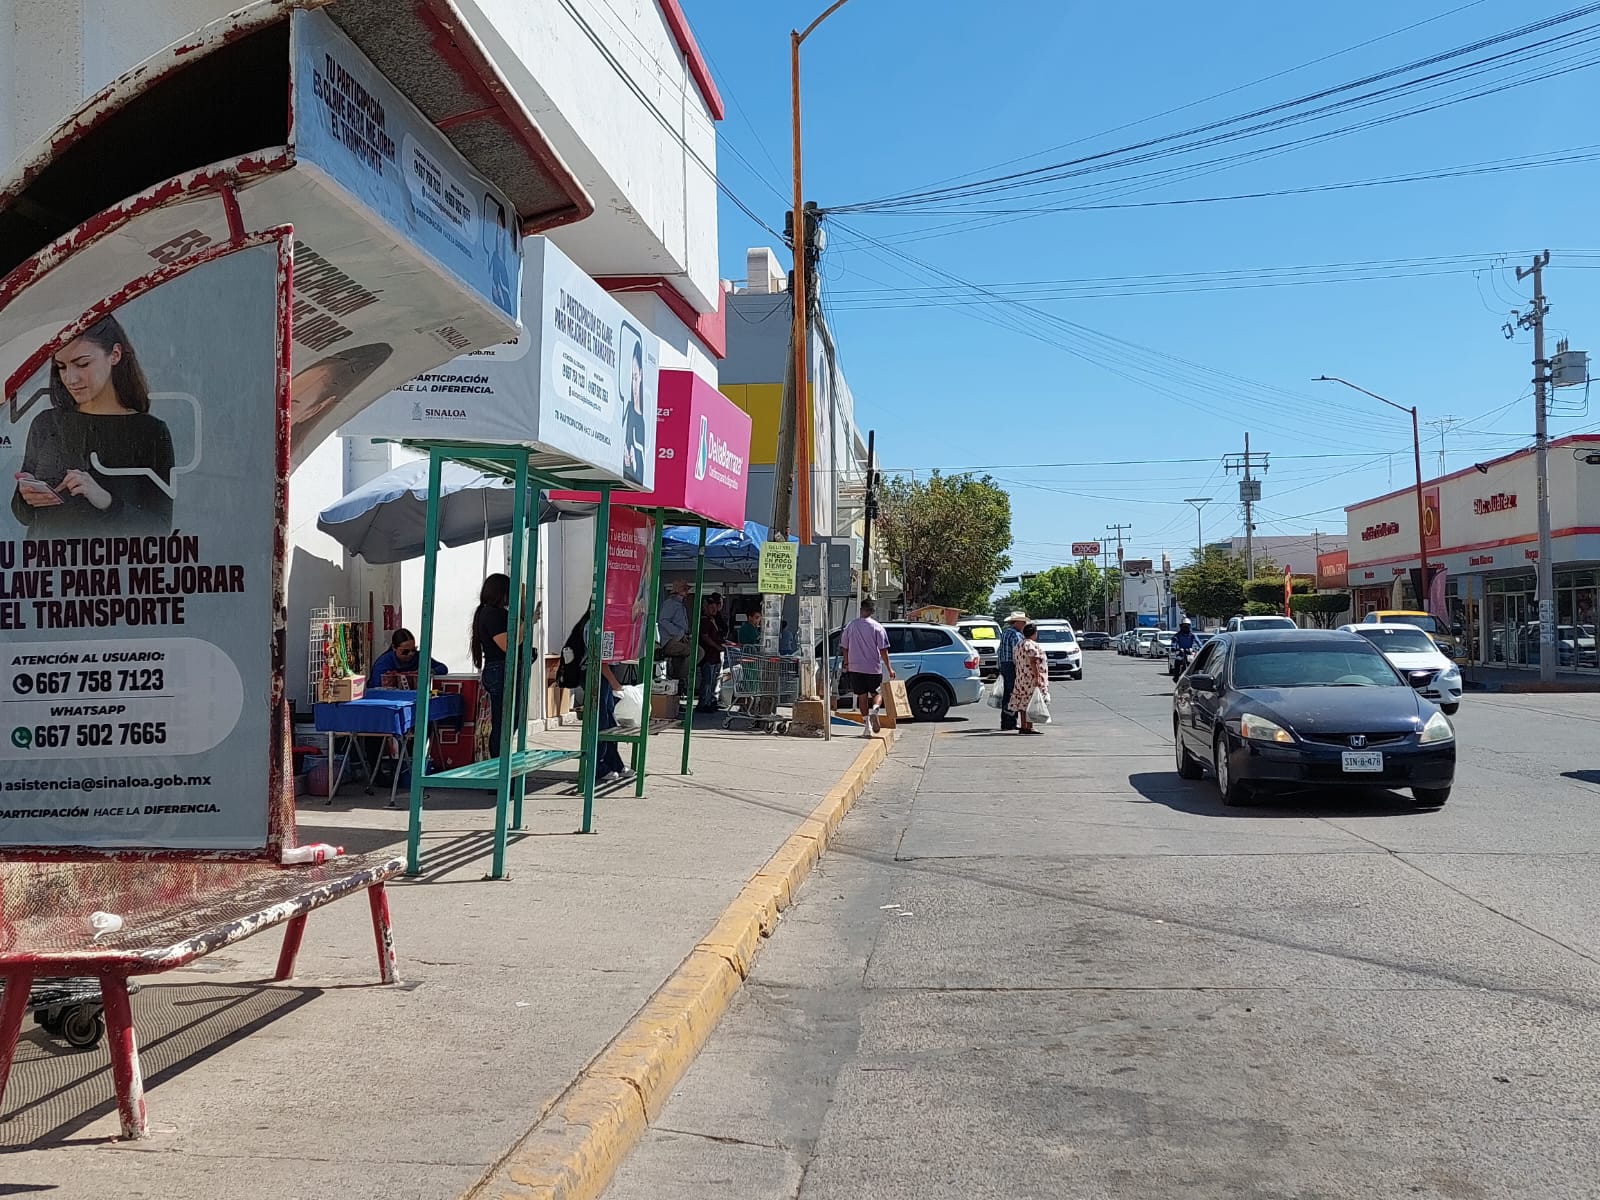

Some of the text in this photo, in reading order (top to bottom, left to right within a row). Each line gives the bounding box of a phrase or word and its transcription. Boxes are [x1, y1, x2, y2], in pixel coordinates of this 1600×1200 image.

[325, 53, 336, 83] TU
[147, 229, 212, 264] ES
[294, 241, 384, 318] RTICIPACIÓN
[431, 385, 494, 394] DIFERENCIA.
[425, 408, 467, 417] SINALOA
[23, 529, 199, 568] PARTICIPACIÓN
[61, 568, 121, 597] PARA
[129, 565, 245, 595] MEJORAR
[0, 597, 185, 629] EL TRANSPORTE
[11, 652, 165, 665] ATENCIÓN AL USUARIO:
[36, 668, 164, 694] 667 758 7123
[50, 705, 126, 717] WHATSAPP
[34, 722, 167, 748] 667 502 7665
[5, 774, 212, 791] asistencia@sinaloa.gob.mx
[94, 807, 124, 817] HACE
[126, 807, 140, 816] LA
[144, 804, 221, 815] DIFERENCIA.
